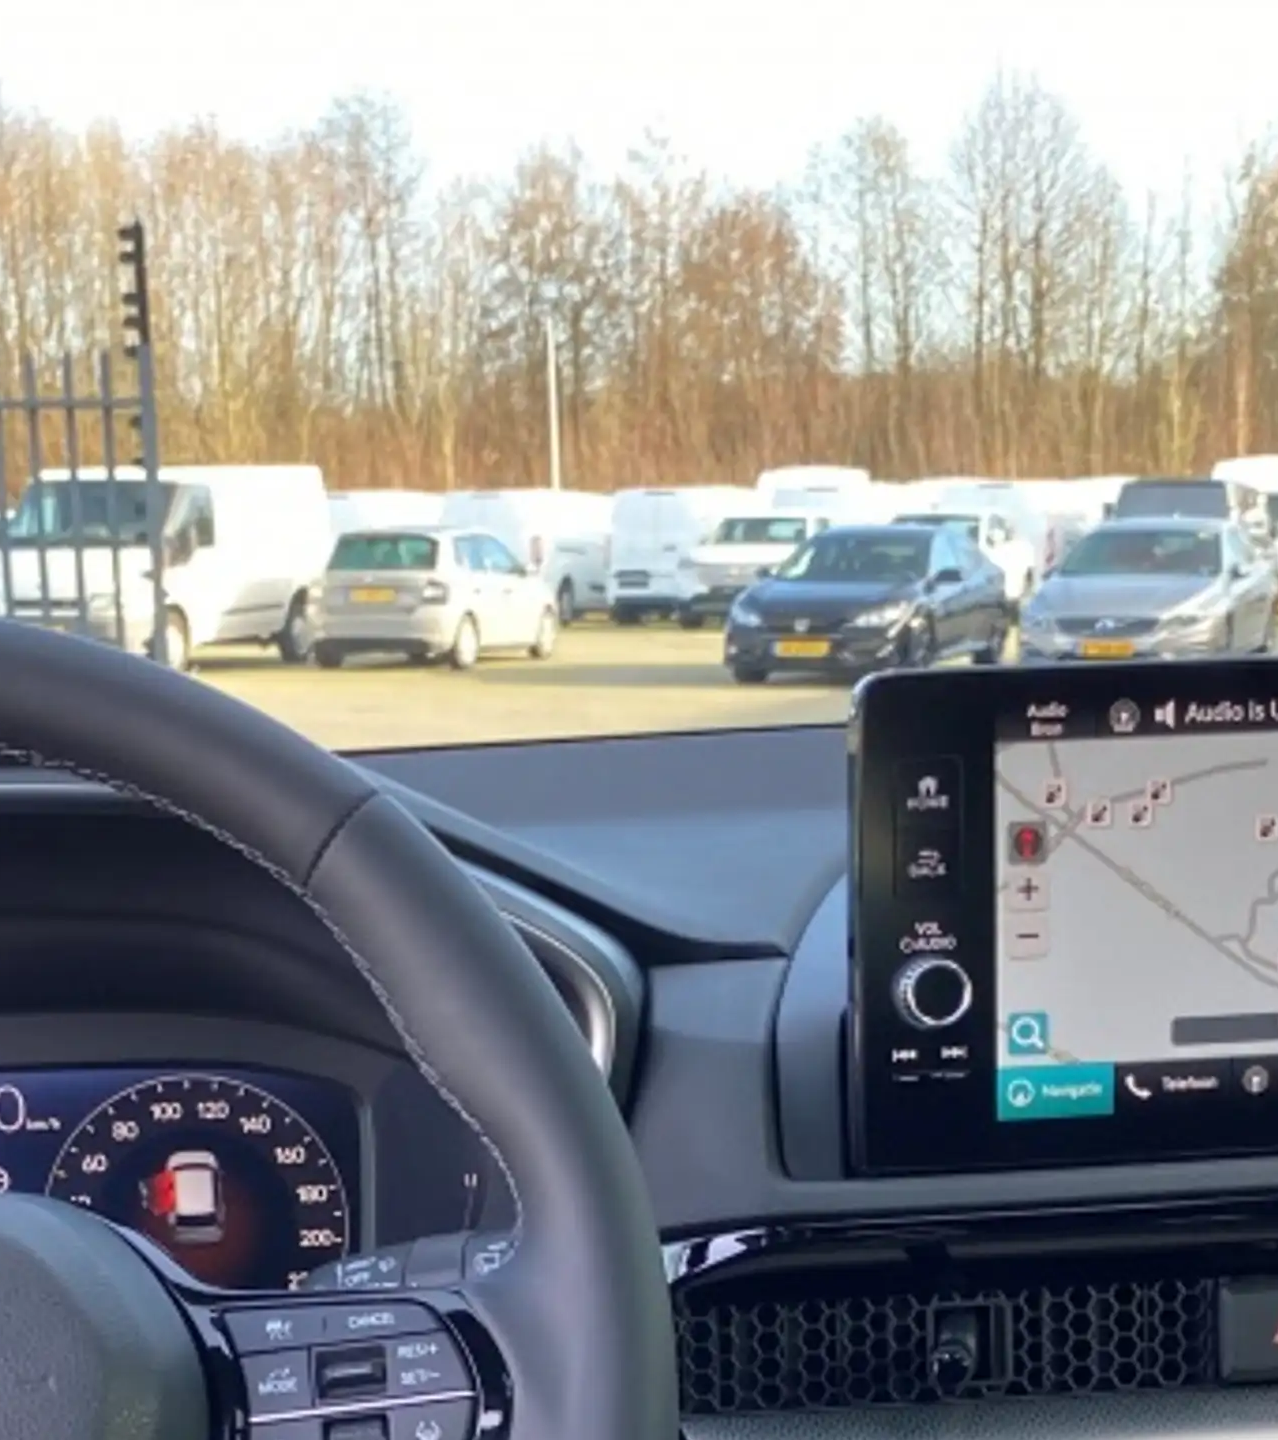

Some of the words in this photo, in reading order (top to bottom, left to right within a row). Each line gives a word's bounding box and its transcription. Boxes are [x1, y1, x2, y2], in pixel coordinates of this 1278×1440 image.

[1026, 702, 1068, 718] Audio
[1184, 699, 1246, 723] Audio
[1247, 699, 1266, 722] is
[914, 921, 943, 936] VOL
[149, 1101, 183, 1122] 100
[196, 1099, 231, 1120] 120
[111, 1120, 140, 1142] 80
[238, 1113, 272, 1135] 140
[81, 1153, 108, 1175] 60
[274, 1145, 307, 1165] 160
[295, 1183, 329, 1204] 180
[297, 1228, 334, 1249] 200
